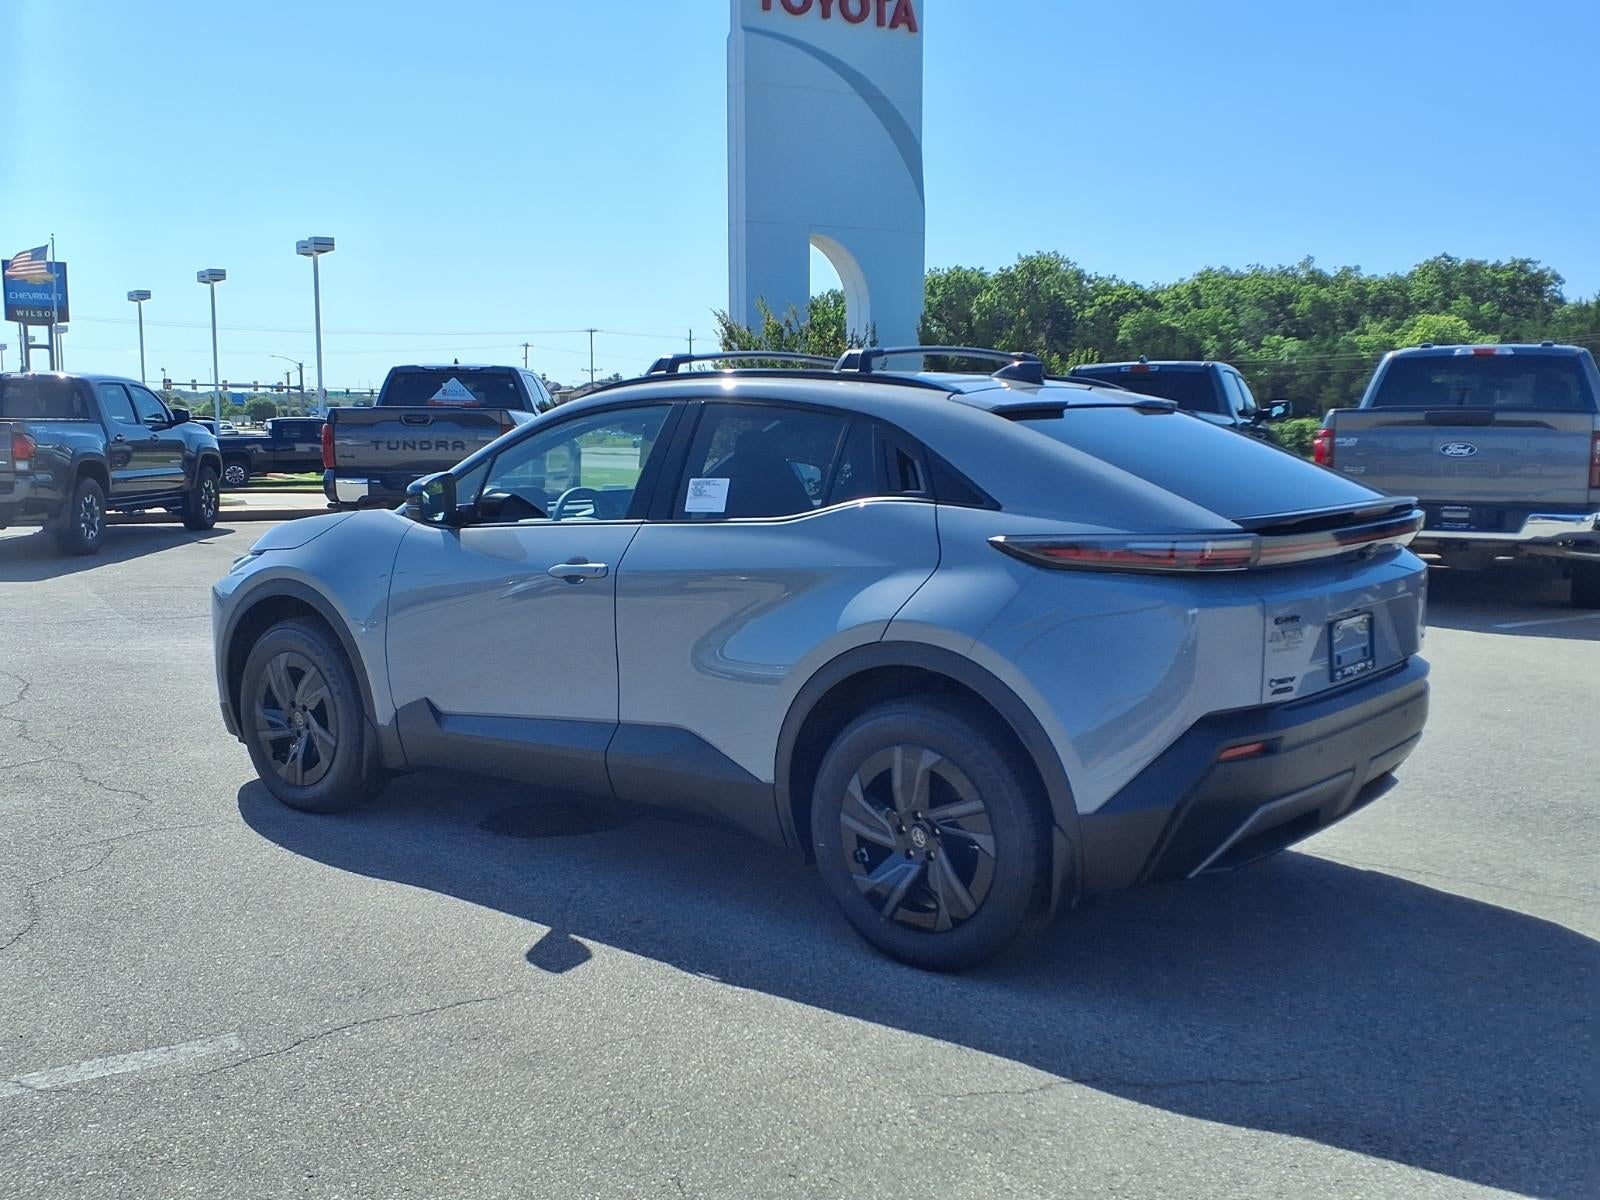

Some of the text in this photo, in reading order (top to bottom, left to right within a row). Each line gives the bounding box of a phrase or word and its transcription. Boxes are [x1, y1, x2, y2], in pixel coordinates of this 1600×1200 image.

[761, 0, 918, 32] YOTA
[370, 440, 466, 451] TUNDRA
[1446, 444, 1471, 454] Ford
